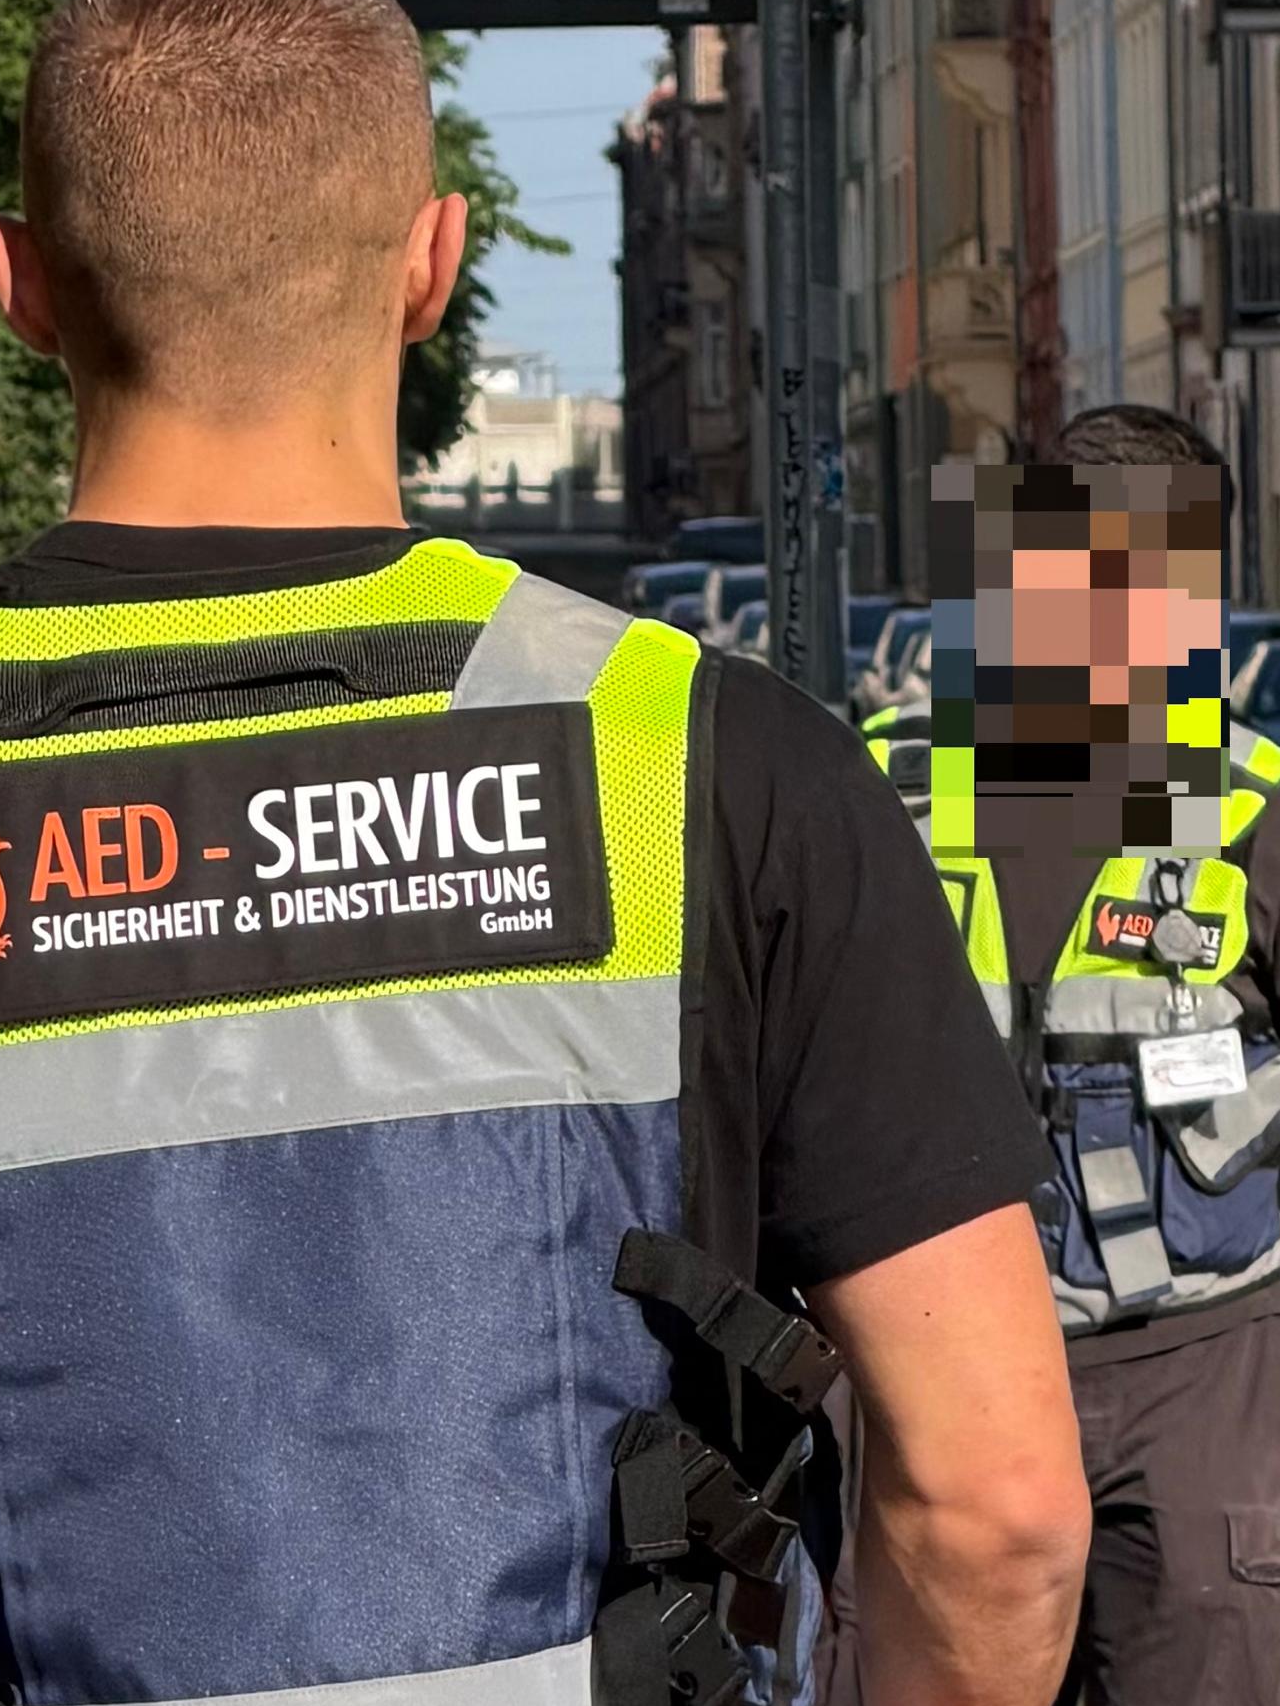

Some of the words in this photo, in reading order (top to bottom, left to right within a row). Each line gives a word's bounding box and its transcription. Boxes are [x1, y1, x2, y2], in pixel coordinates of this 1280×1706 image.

[30, 803, 179, 903] AED
[247, 762, 547, 880] SERVICE
[31, 895, 225, 953] SICHERHEIT
[233, 895, 262, 933] &
[270, 863, 551, 929] DIENSTLEISTUNG
[479, 907, 554, 935] GmbH
[1123, 913, 1154, 937] AED
